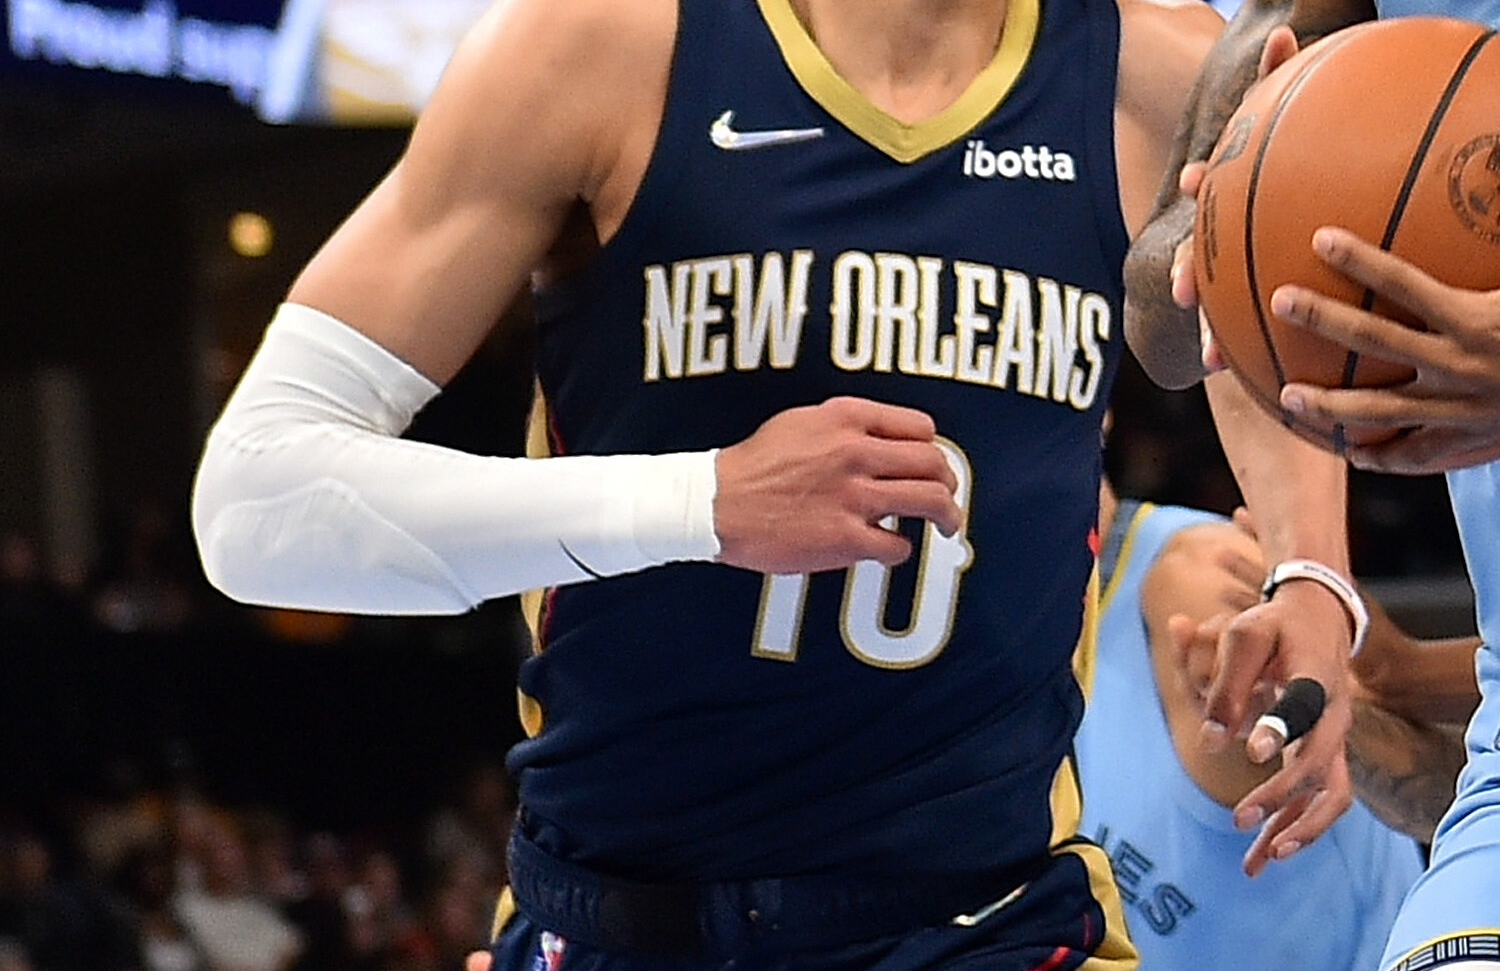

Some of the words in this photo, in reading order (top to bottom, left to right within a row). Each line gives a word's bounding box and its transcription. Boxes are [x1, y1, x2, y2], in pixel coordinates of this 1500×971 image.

[963, 141, 1076, 181] ibotta
[643, 248, 815, 383] NEW
[829, 250, 1111, 412] ORLEANS
